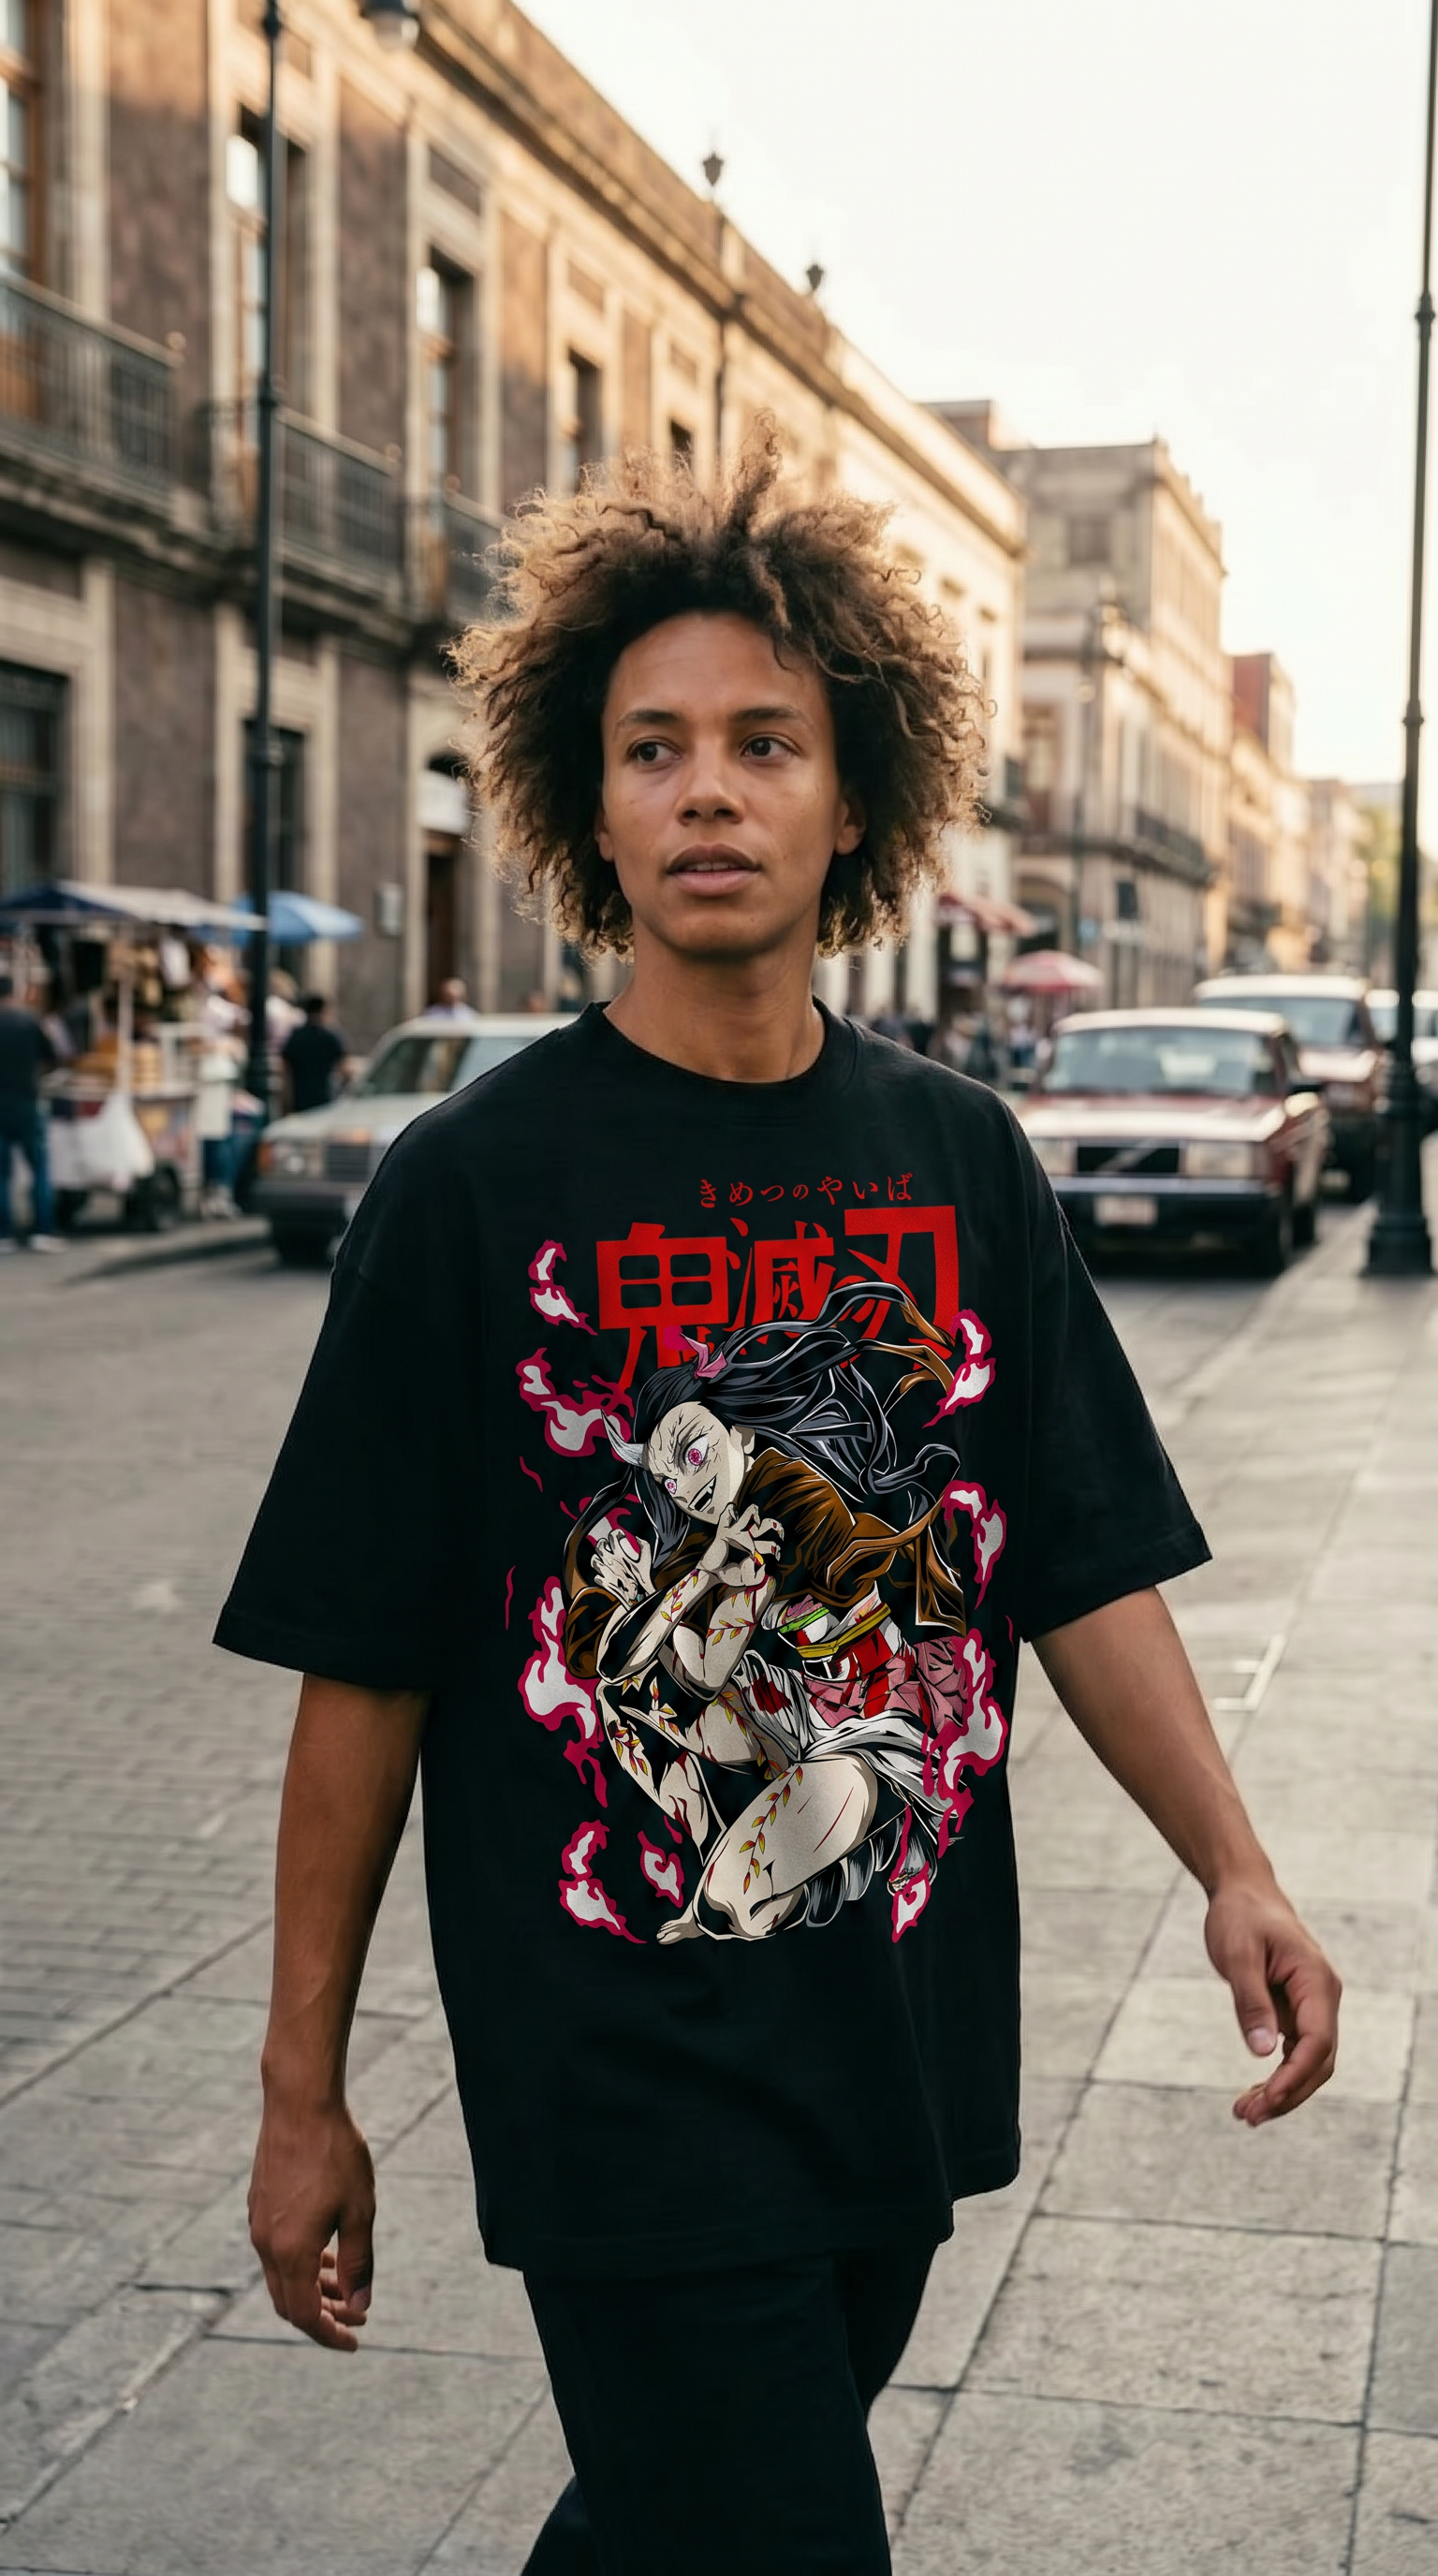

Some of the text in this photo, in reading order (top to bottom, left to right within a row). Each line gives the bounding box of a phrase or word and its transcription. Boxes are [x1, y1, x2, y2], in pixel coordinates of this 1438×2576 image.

[699, 1172, 914, 1208] きめつのやいば
